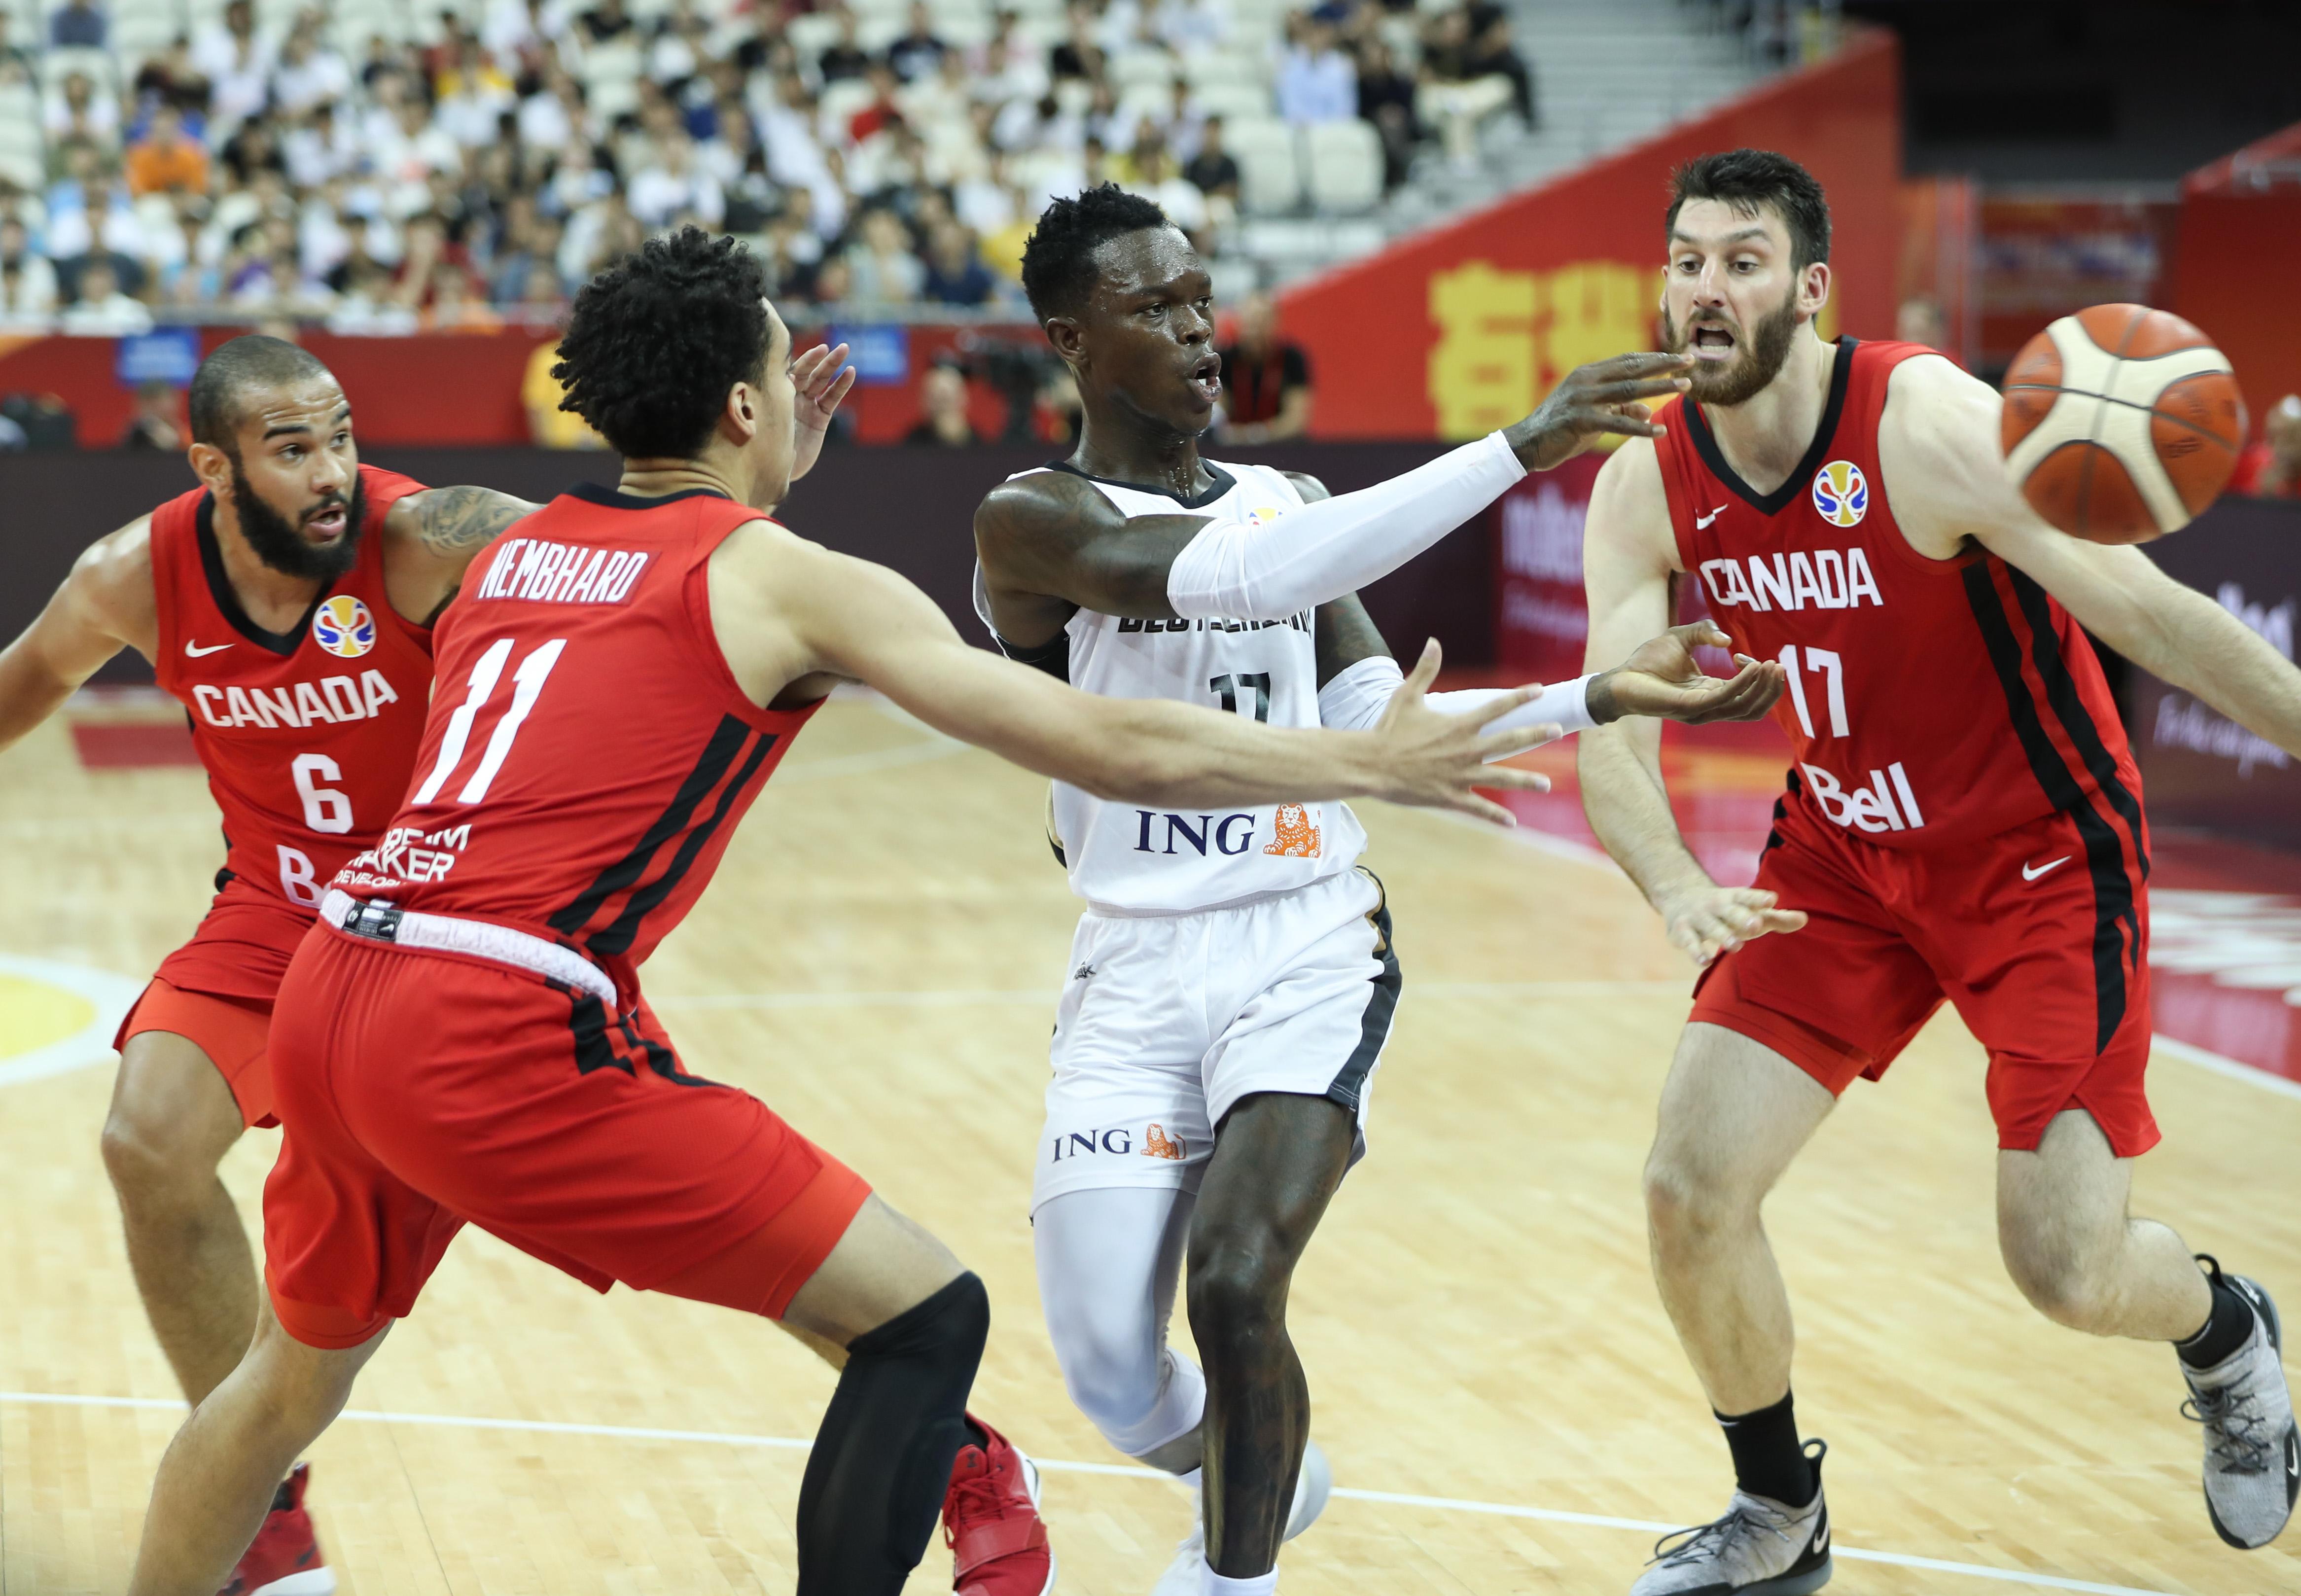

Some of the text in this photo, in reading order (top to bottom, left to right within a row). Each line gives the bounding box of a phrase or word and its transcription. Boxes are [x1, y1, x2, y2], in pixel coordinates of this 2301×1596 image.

[478, 538, 648, 602] NEMBHARD
[1699, 547, 1884, 611] CANADA
[192, 669, 398, 728] CANADA
[412, 638, 567, 804] 11
[1778, 644, 1850, 739] 17
[291, 753, 354, 834] 6
[1800, 762, 1925, 833] Bell
[1133, 810, 1255, 856] ING
[1052, 1129, 1133, 1163] ING
